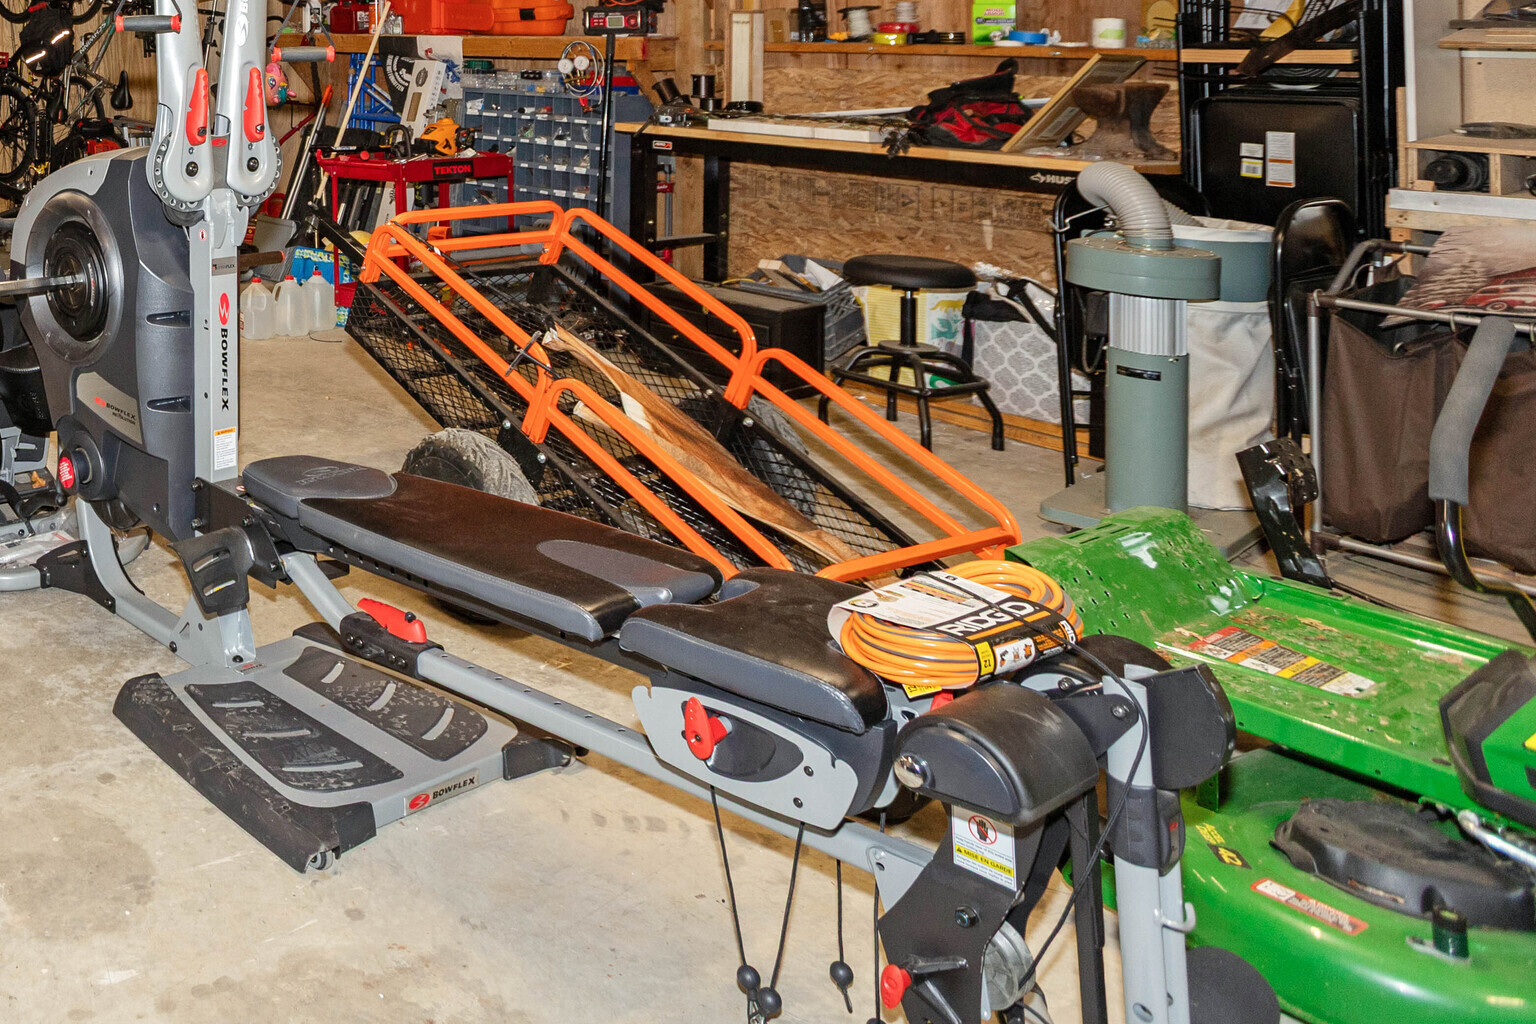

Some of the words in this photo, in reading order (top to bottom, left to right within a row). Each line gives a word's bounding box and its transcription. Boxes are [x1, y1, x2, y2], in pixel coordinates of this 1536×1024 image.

[434, 165, 472, 175] TEKTON
[221, 328, 229, 411] BOWFLEX
[106, 403, 137, 420] BOWFLEX
[936, 602, 1036, 636] RIDGD
[432, 777, 475, 800] BOWFLEX
[964, 850, 979, 860] MISE
[990, 861, 1012, 875] GARDE
